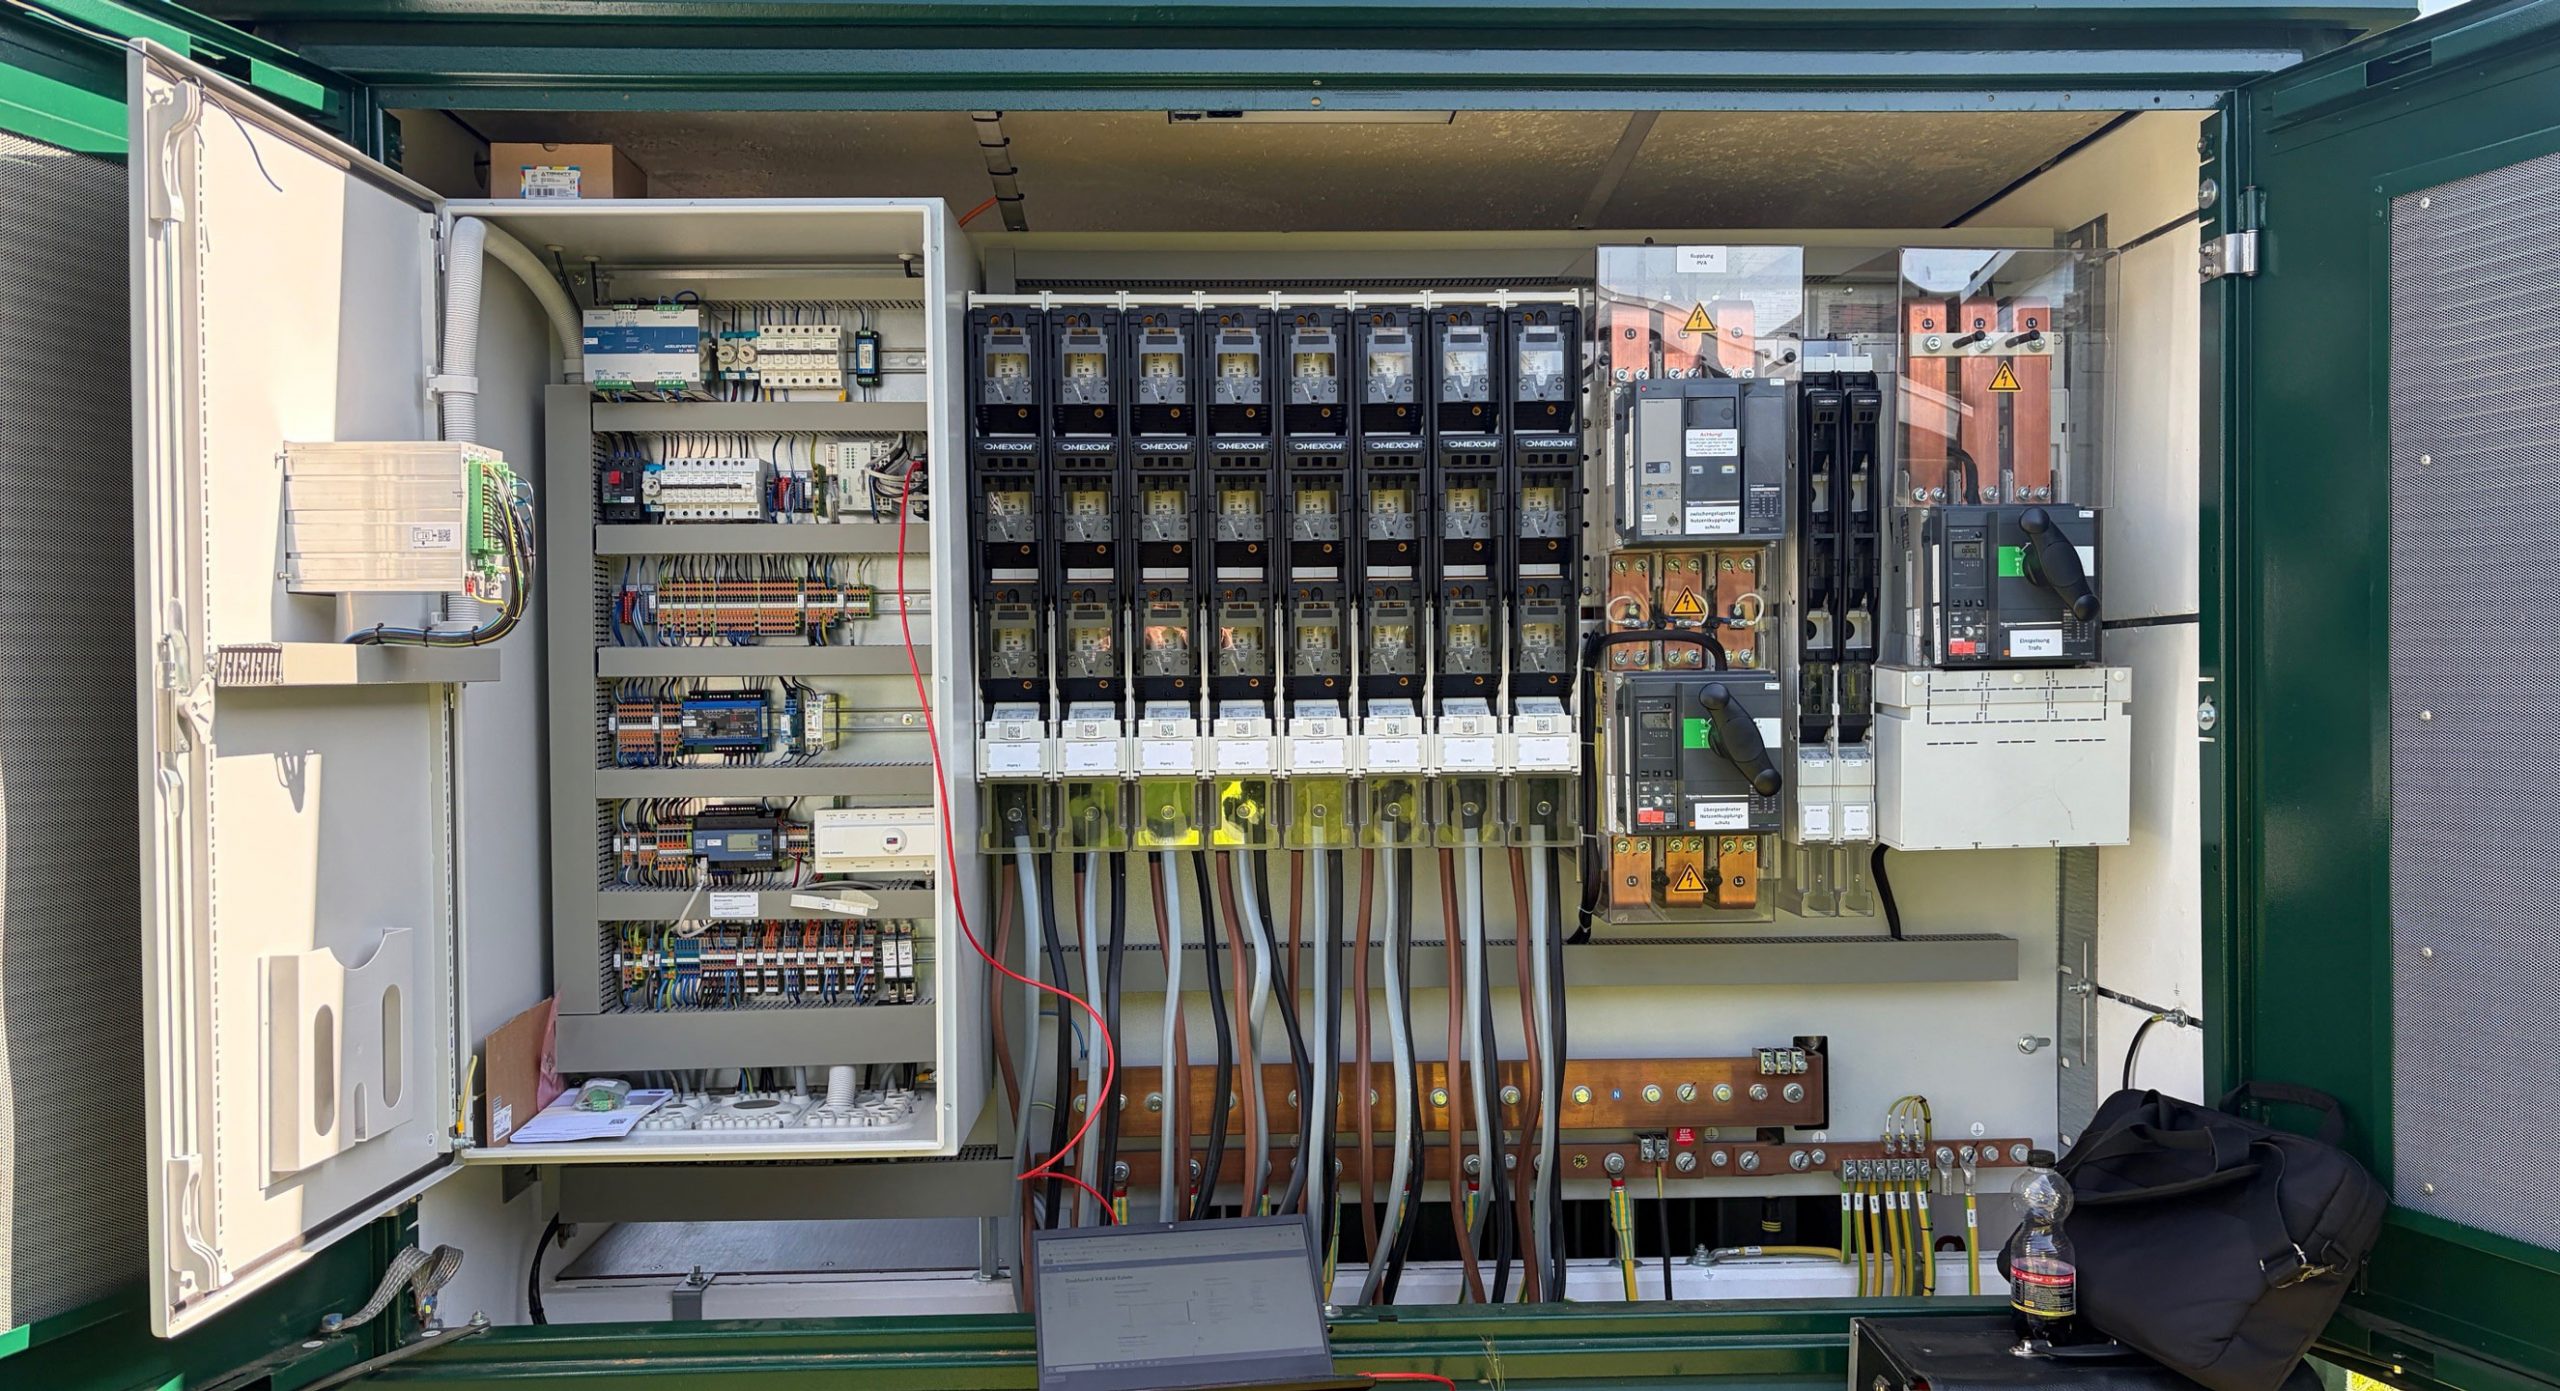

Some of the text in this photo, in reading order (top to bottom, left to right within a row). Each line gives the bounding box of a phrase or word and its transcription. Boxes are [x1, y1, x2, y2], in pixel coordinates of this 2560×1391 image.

[984, 443, 1032, 451] OMEXOM
[1062, 443, 1110, 451] OMEXOM
[1217, 442, 1265, 450] OMEXOM
[1295, 442, 1342, 450] OMEXOM
[1613, 1090, 1620, 1099] N
